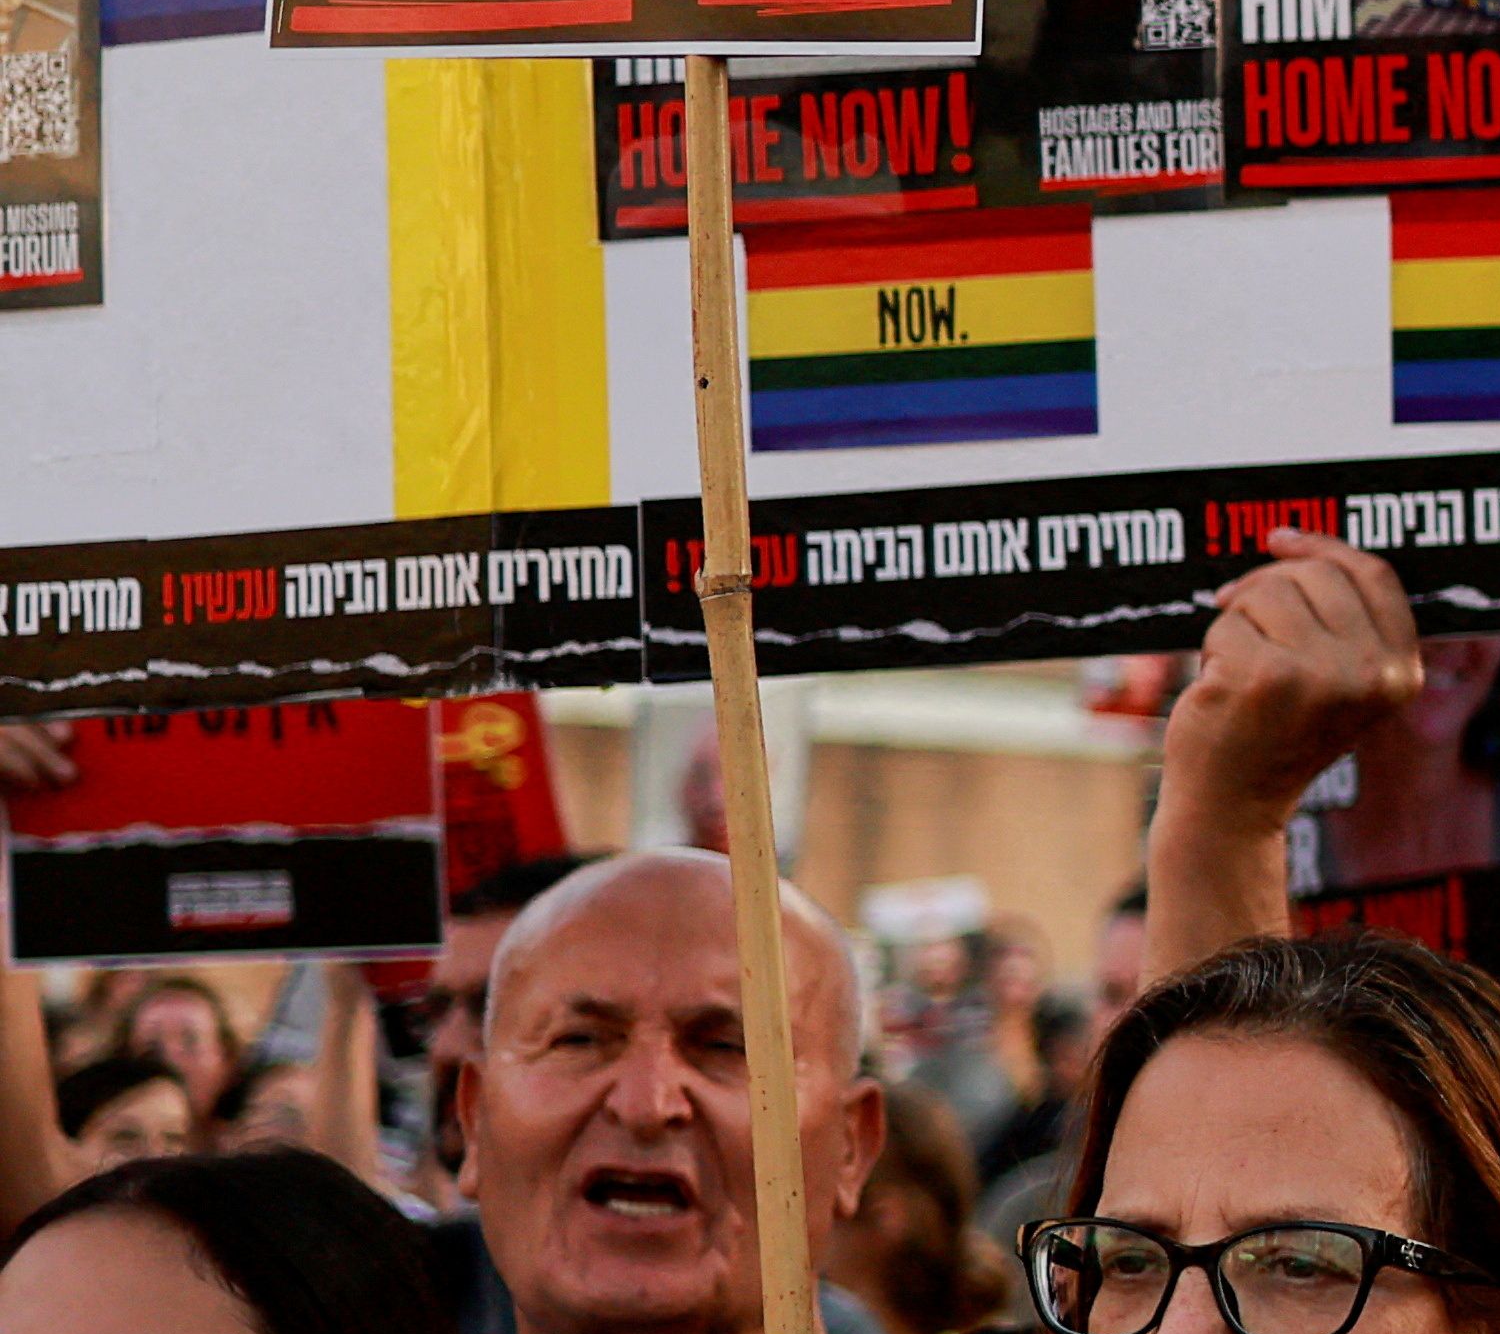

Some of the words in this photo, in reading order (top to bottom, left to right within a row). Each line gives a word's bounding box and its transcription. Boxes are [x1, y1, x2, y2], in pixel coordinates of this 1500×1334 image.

[616, 94, 782, 190] HOE
[800, 71, 973, 180] NOW!
[1038, 104, 1133, 138] HOSTAGES
[1136, 101, 1173, 133] AND
[1242, 53, 1407, 150] HOME
[1040, 130, 1159, 182] FAMILIES
[877, 284, 969, 347] NOW.
[934, 518, 1032, 577] אותם
[1039, 507, 1184, 571] מחזירים
[1345, 489, 1465, 550] הביתה
[396, 552, 481, 610] אותם
[488, 544, 633, 606] מחזירים
[806, 523, 925, 586] הביתה
[15, 577, 142, 637] מחזירים
[285, 558, 387, 619] הביתה
